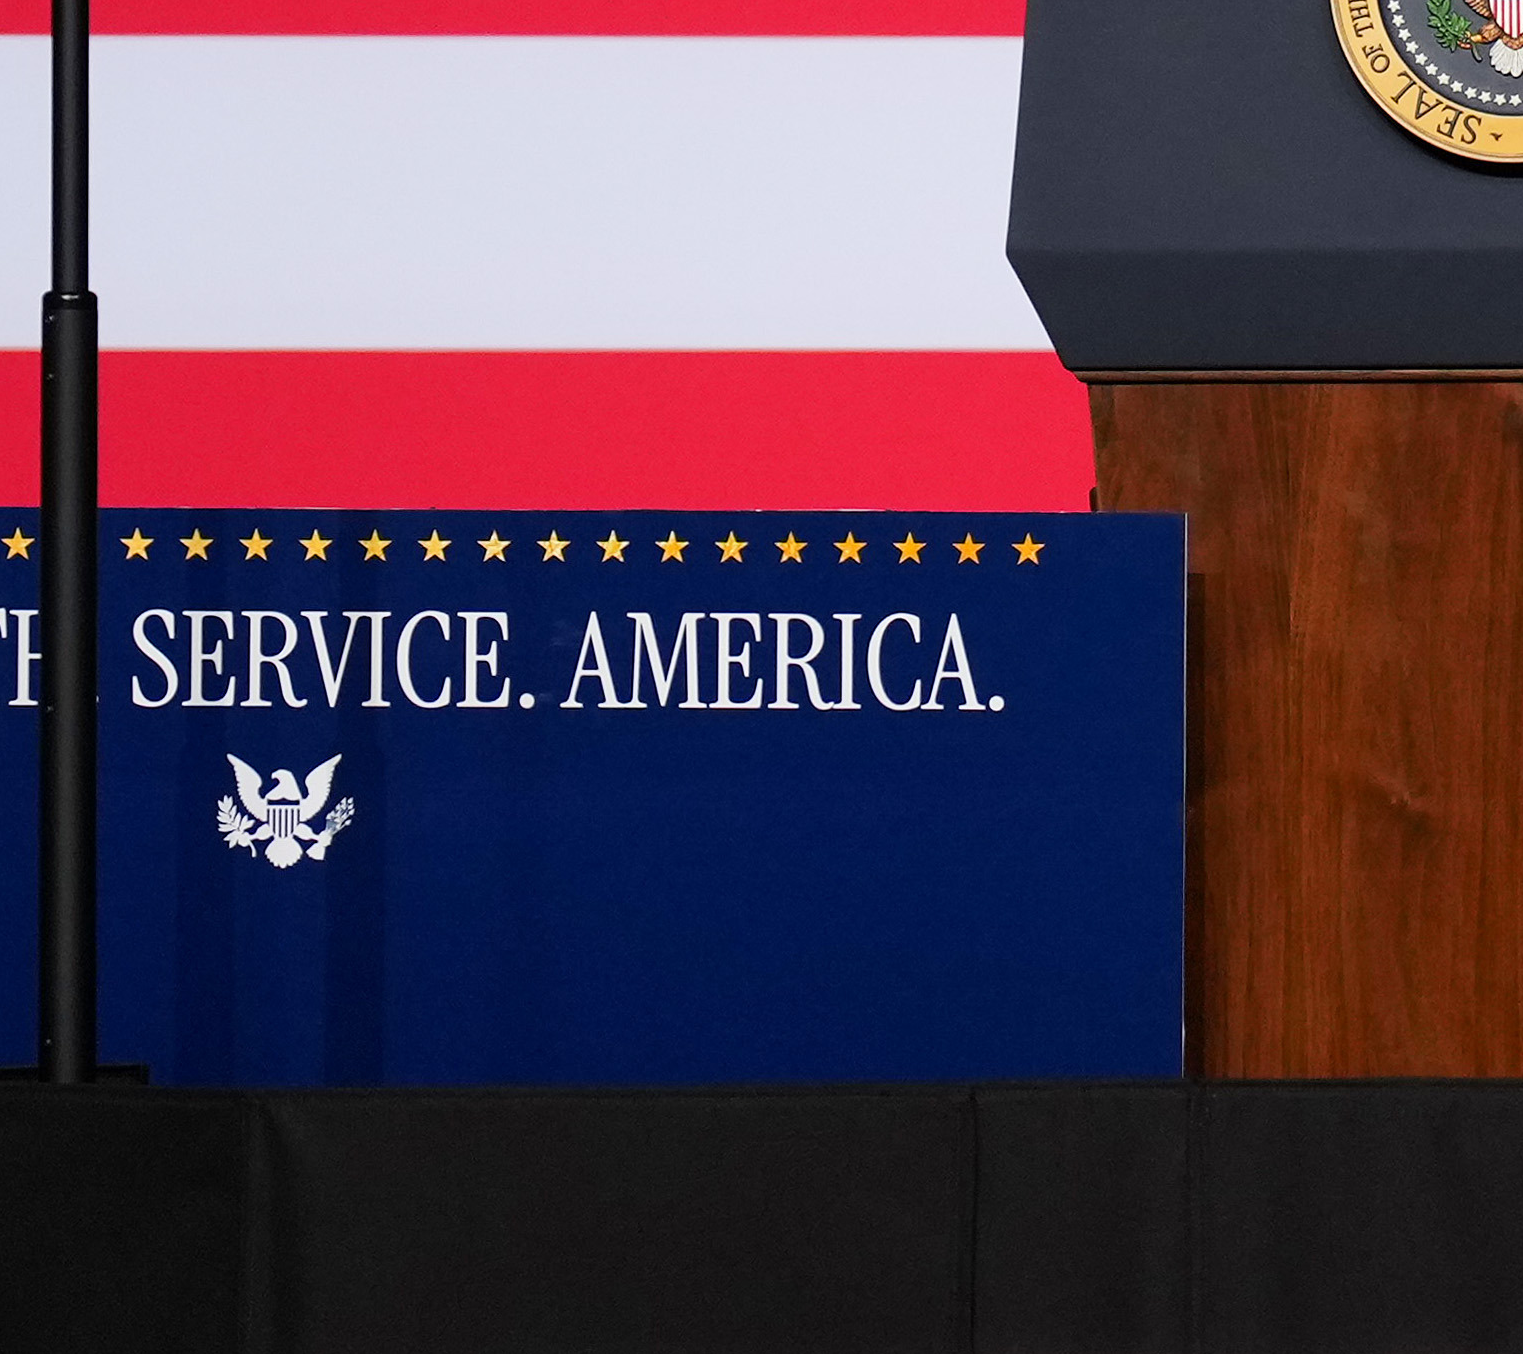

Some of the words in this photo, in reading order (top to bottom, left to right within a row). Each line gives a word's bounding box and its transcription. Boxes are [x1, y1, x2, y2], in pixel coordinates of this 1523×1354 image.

[1362, 42, 1391, 75] OF
[1391, 68, 1484, 146] SEAL
[132, 608, 535, 709] SERVICE.
[559, 611, 1005, 712] AMERICA.
